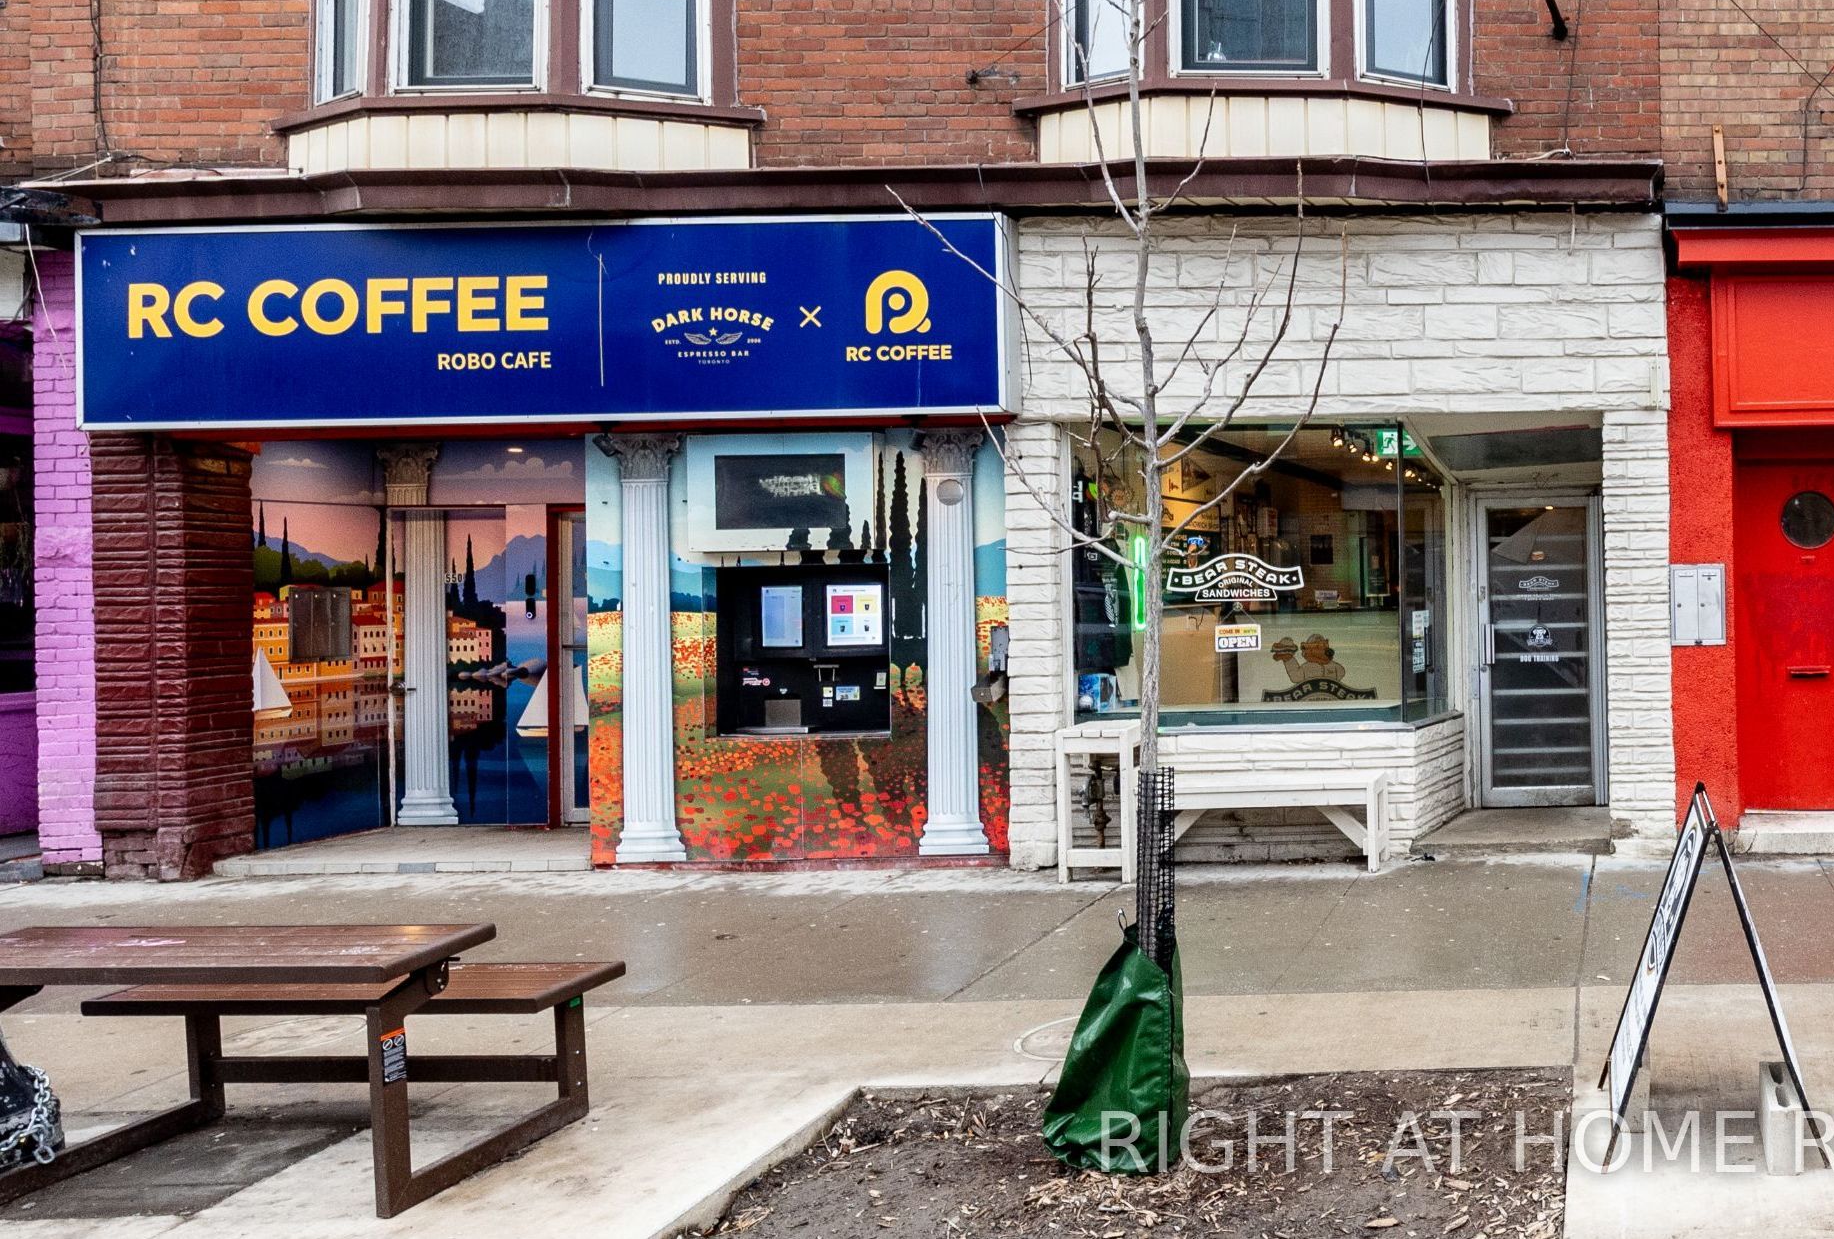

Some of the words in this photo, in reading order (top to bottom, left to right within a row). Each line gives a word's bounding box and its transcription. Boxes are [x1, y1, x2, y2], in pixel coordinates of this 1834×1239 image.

[658, 272, 711, 285] PROUDLY
[715, 271, 766, 284] SERVING
[127, 281, 225, 339] RC
[247, 274, 549, 337] COFFEE
[651, 307, 704, 334] DARK
[709, 306, 775, 333] HORSE
[677, 350, 727, 359] ESPRESSO
[731, 350, 750, 358] BAR
[846, 346, 872, 363] RC
[876, 344, 953, 362] COFFEE
[437, 352, 496, 372] ROBO
[501, 351, 552, 371] CAFE
[445, 573, 463, 583] 550
[1181, 562, 1228, 586] BEAR
[1234, 559, 1292, 585] STEAK
[1218, 576, 1254, 589] ORIGINAL
[1202, 588, 1271, 599] SANDWICHES
[1218, 636, 1257, 649] OPEN
